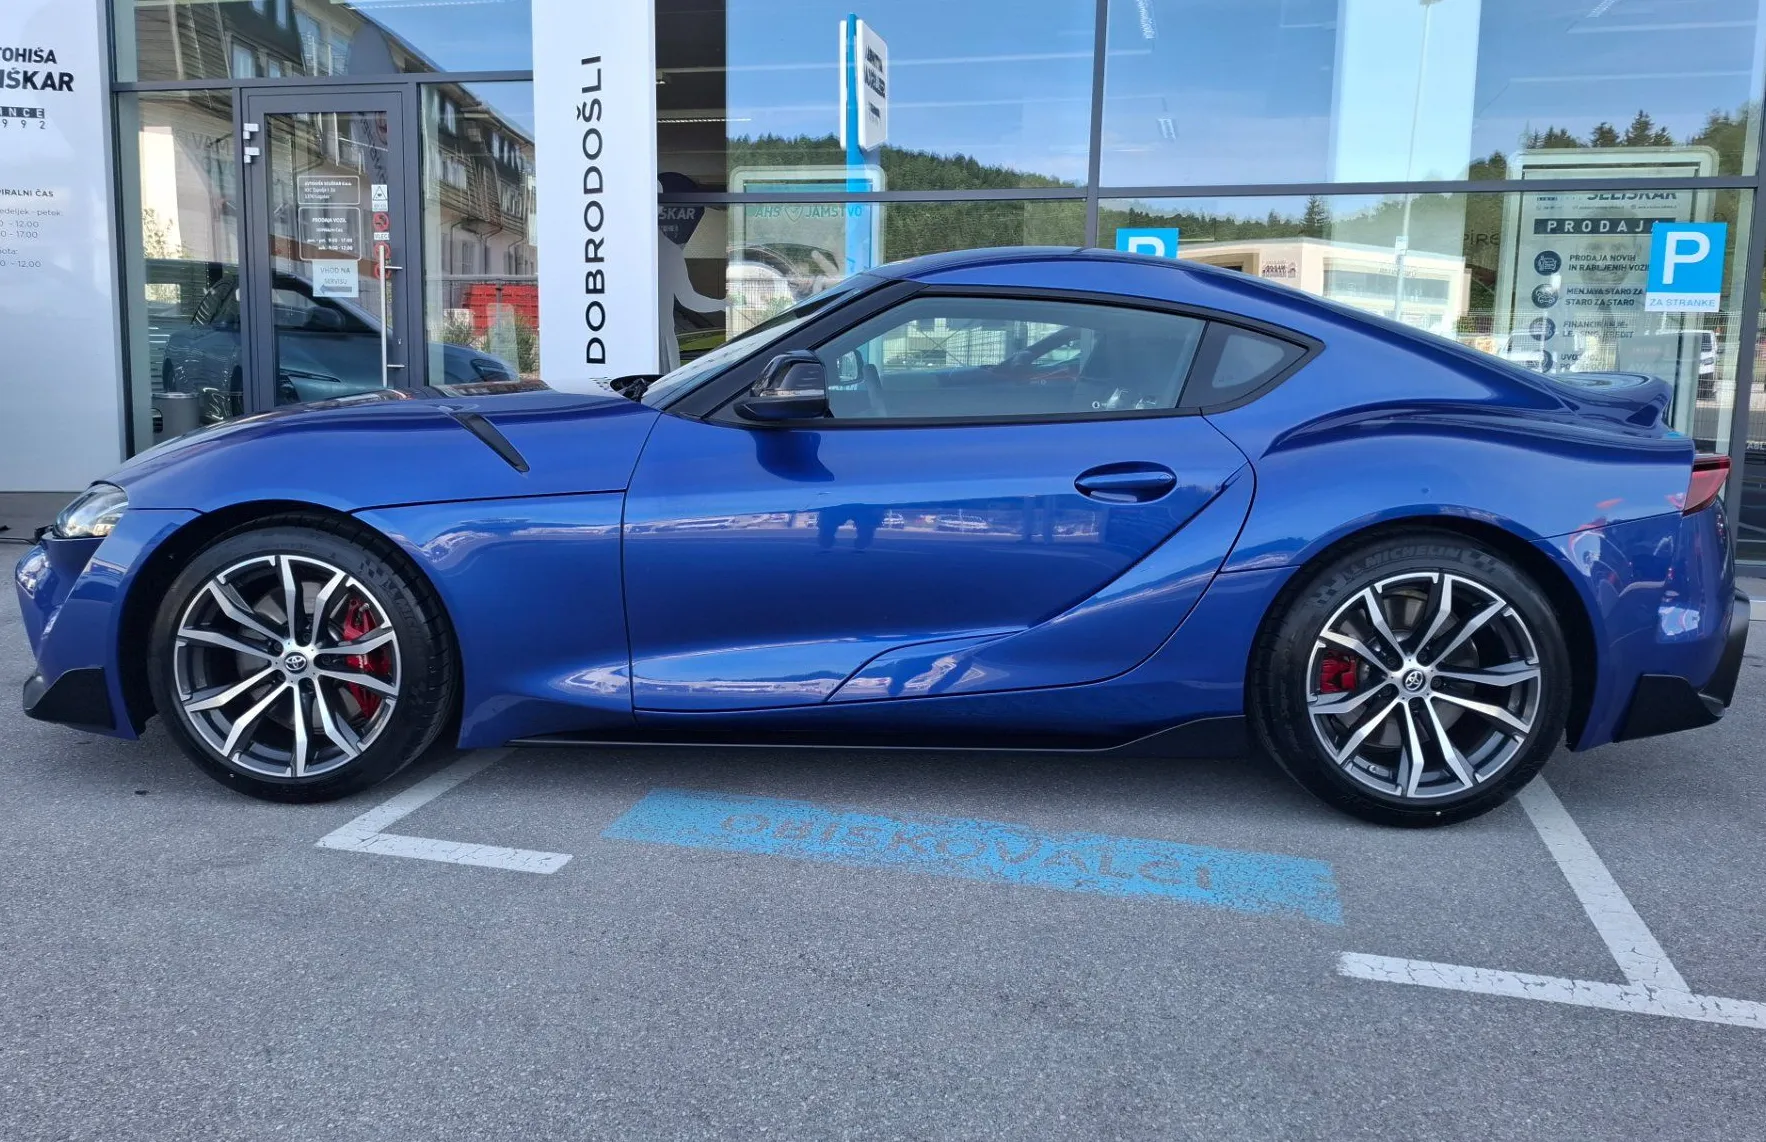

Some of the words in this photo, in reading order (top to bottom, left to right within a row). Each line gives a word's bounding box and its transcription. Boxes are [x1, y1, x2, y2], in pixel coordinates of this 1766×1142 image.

[0, 47, 57, 64] OHIŠA
[35, 189, 54, 197] ČAS
[576, 55, 606, 364] DOBRODOŠLI
[1547, 220, 1659, 233] PRODAJ
[1662, 231, 1711, 284] P
[1579, 264, 1627, 272] RABLJENIH
[1650, 298, 1663, 306] ZA
[1666, 298, 1716, 307] STRANKE
